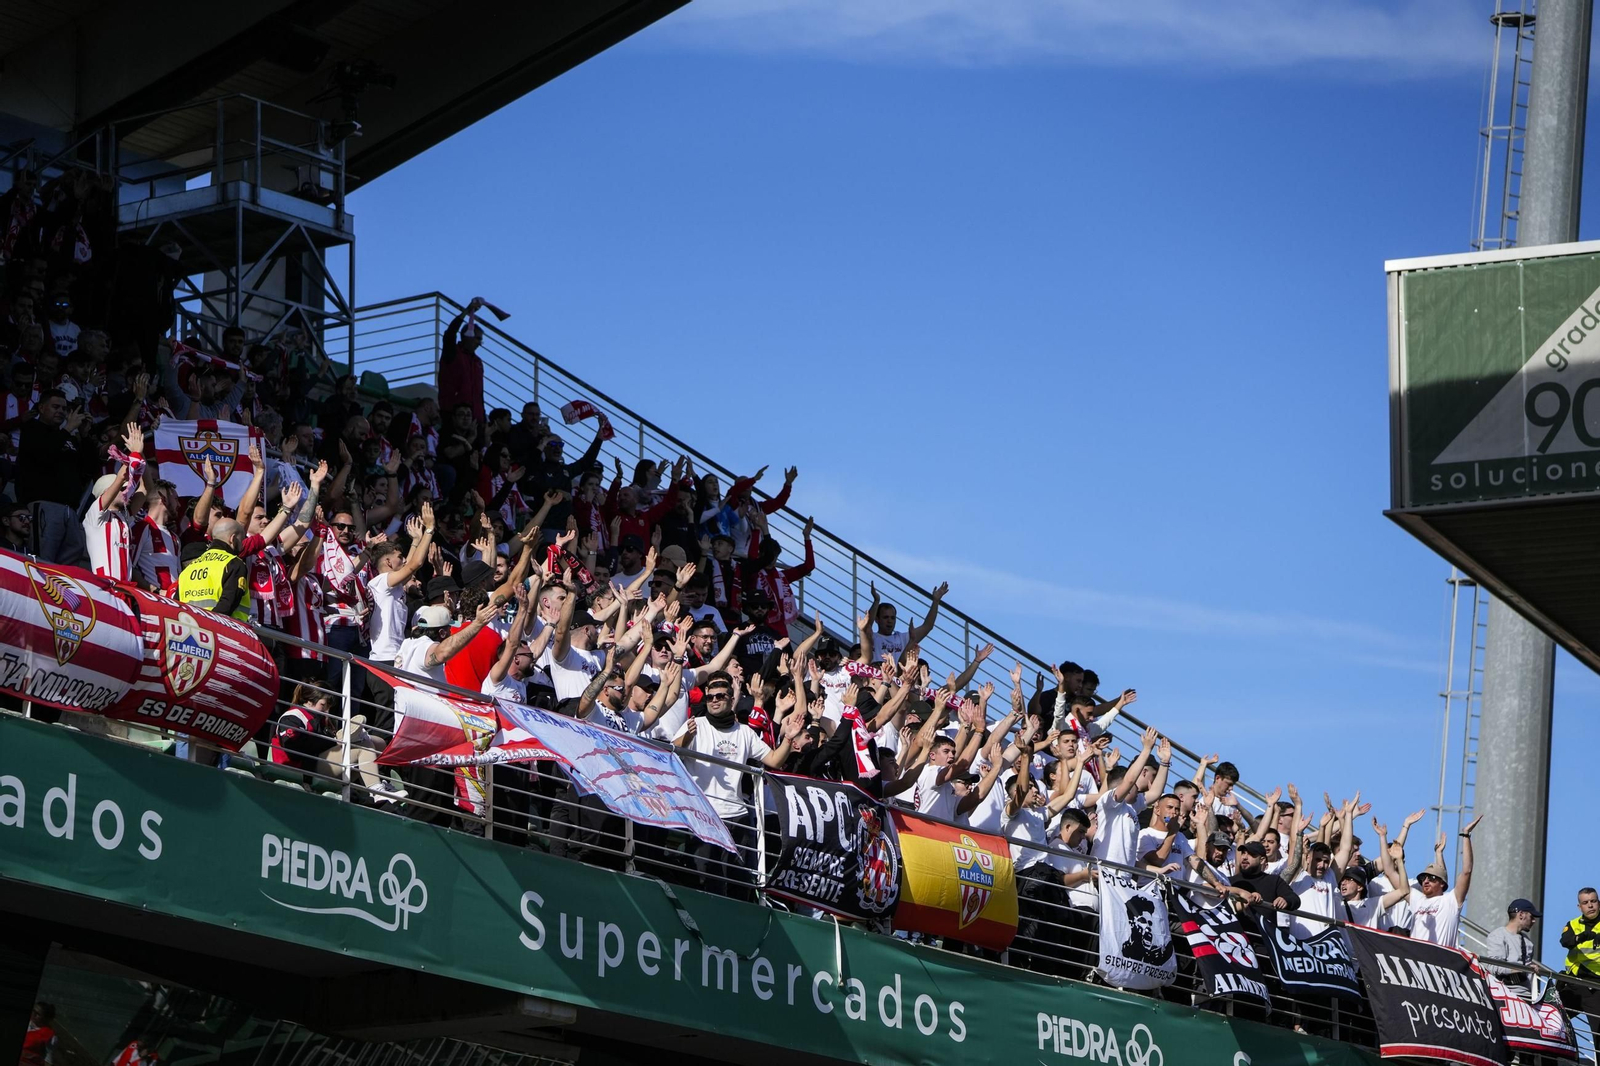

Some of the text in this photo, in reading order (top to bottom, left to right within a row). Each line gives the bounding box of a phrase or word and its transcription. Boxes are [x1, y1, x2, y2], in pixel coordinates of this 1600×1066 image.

[189, 453, 231, 463] ALMERIA
[56, 629, 80, 642] ALMERIA
[169, 640, 211, 660] ALMERIA
[137, 698, 249, 744] ES DE PRIMERA
[791, 846, 847, 879] SIEMPRE
[960, 868, 994, 886] ALMERIA
[771, 869, 846, 904] PRESENTE
[518, 890, 967, 1043] Supermercados
[1105, 954, 1142, 974] SIEMPRE
[1375, 953, 1494, 1011] ALMERIA
[1401, 1000, 1497, 1044] presente
